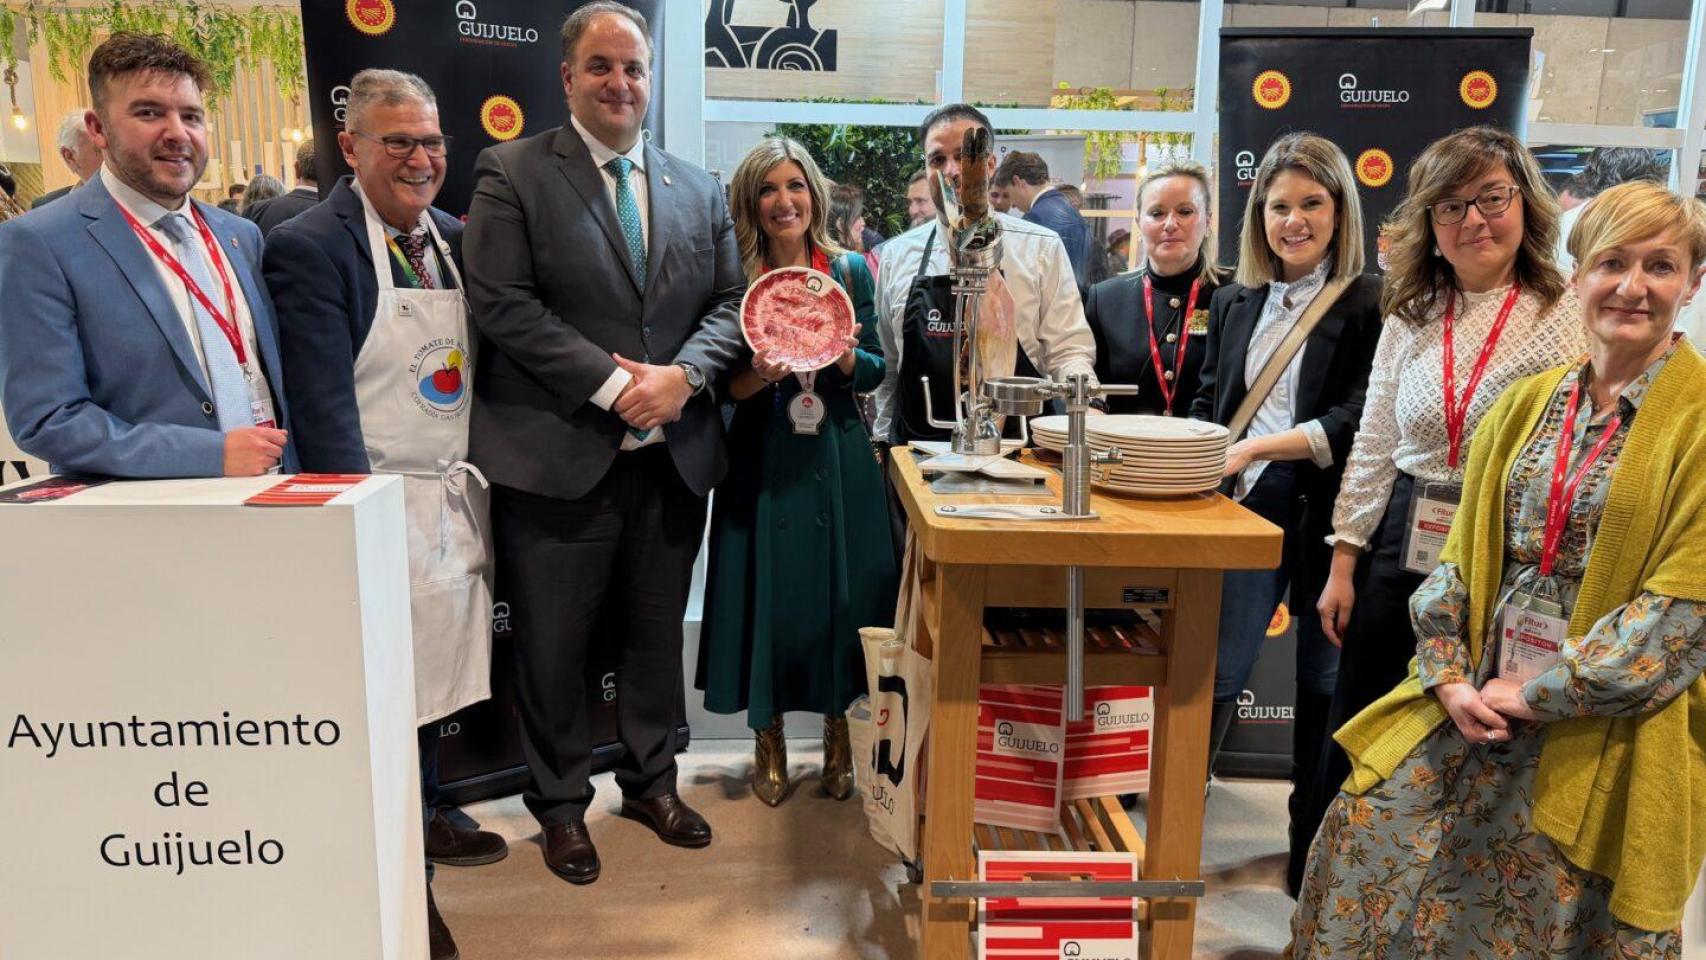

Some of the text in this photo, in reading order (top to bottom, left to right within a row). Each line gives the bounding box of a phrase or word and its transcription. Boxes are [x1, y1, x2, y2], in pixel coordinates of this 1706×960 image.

[458, 20, 539, 43] GUIJUELO
[1340, 90, 1410, 103] GUIJUELO
[1097, 712, 1150, 726] GUIJUELO
[1237, 706, 1296, 719] GUIJUEL
[7, 711, 341, 758] Ayuntamiento
[998, 736, 1060, 754] GUIJUELO
[154, 770, 210, 807] de
[100, 829, 285, 876] Guijuelo
